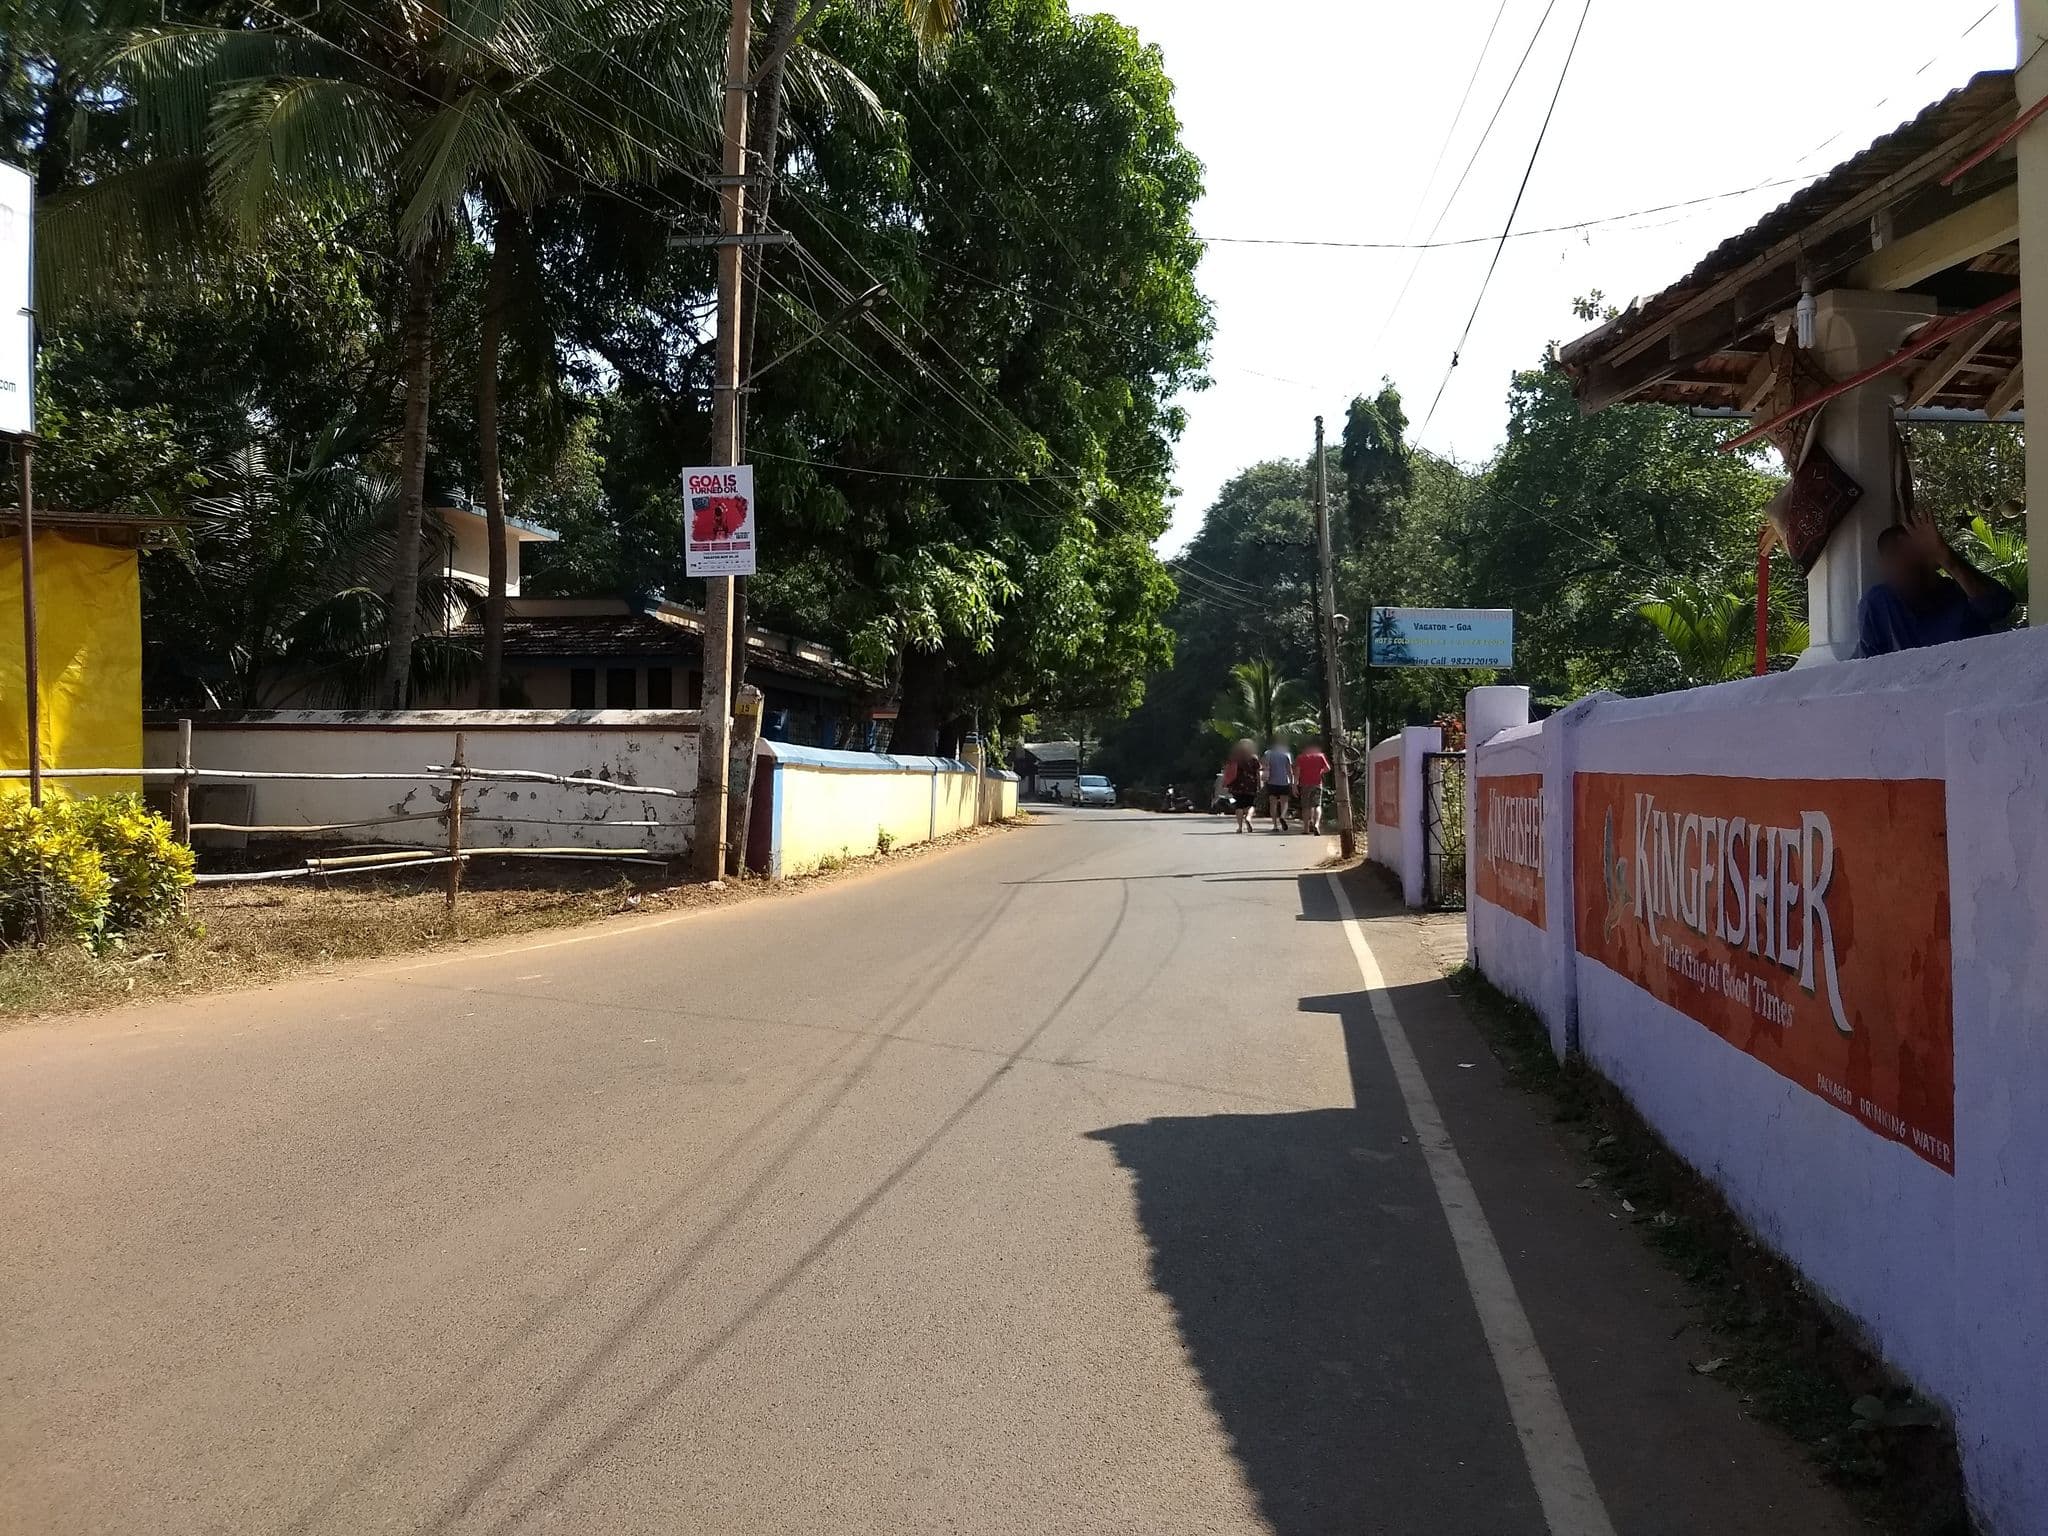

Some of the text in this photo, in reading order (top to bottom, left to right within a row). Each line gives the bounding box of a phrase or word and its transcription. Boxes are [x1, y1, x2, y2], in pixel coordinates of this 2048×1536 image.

[689, 474, 737, 487] GOA IS
[1430, 657, 1446, 665] Call
[1451, 657, 1499, 665] 9822120159
[741, 704, 750, 712] 15
[1634, 792, 1852, 1032] KINGFISHER
[1661, 934, 1795, 1029] The King of Good Times
[1817, 1072, 1951, 1163] PACKAGED DRINKING WATER
